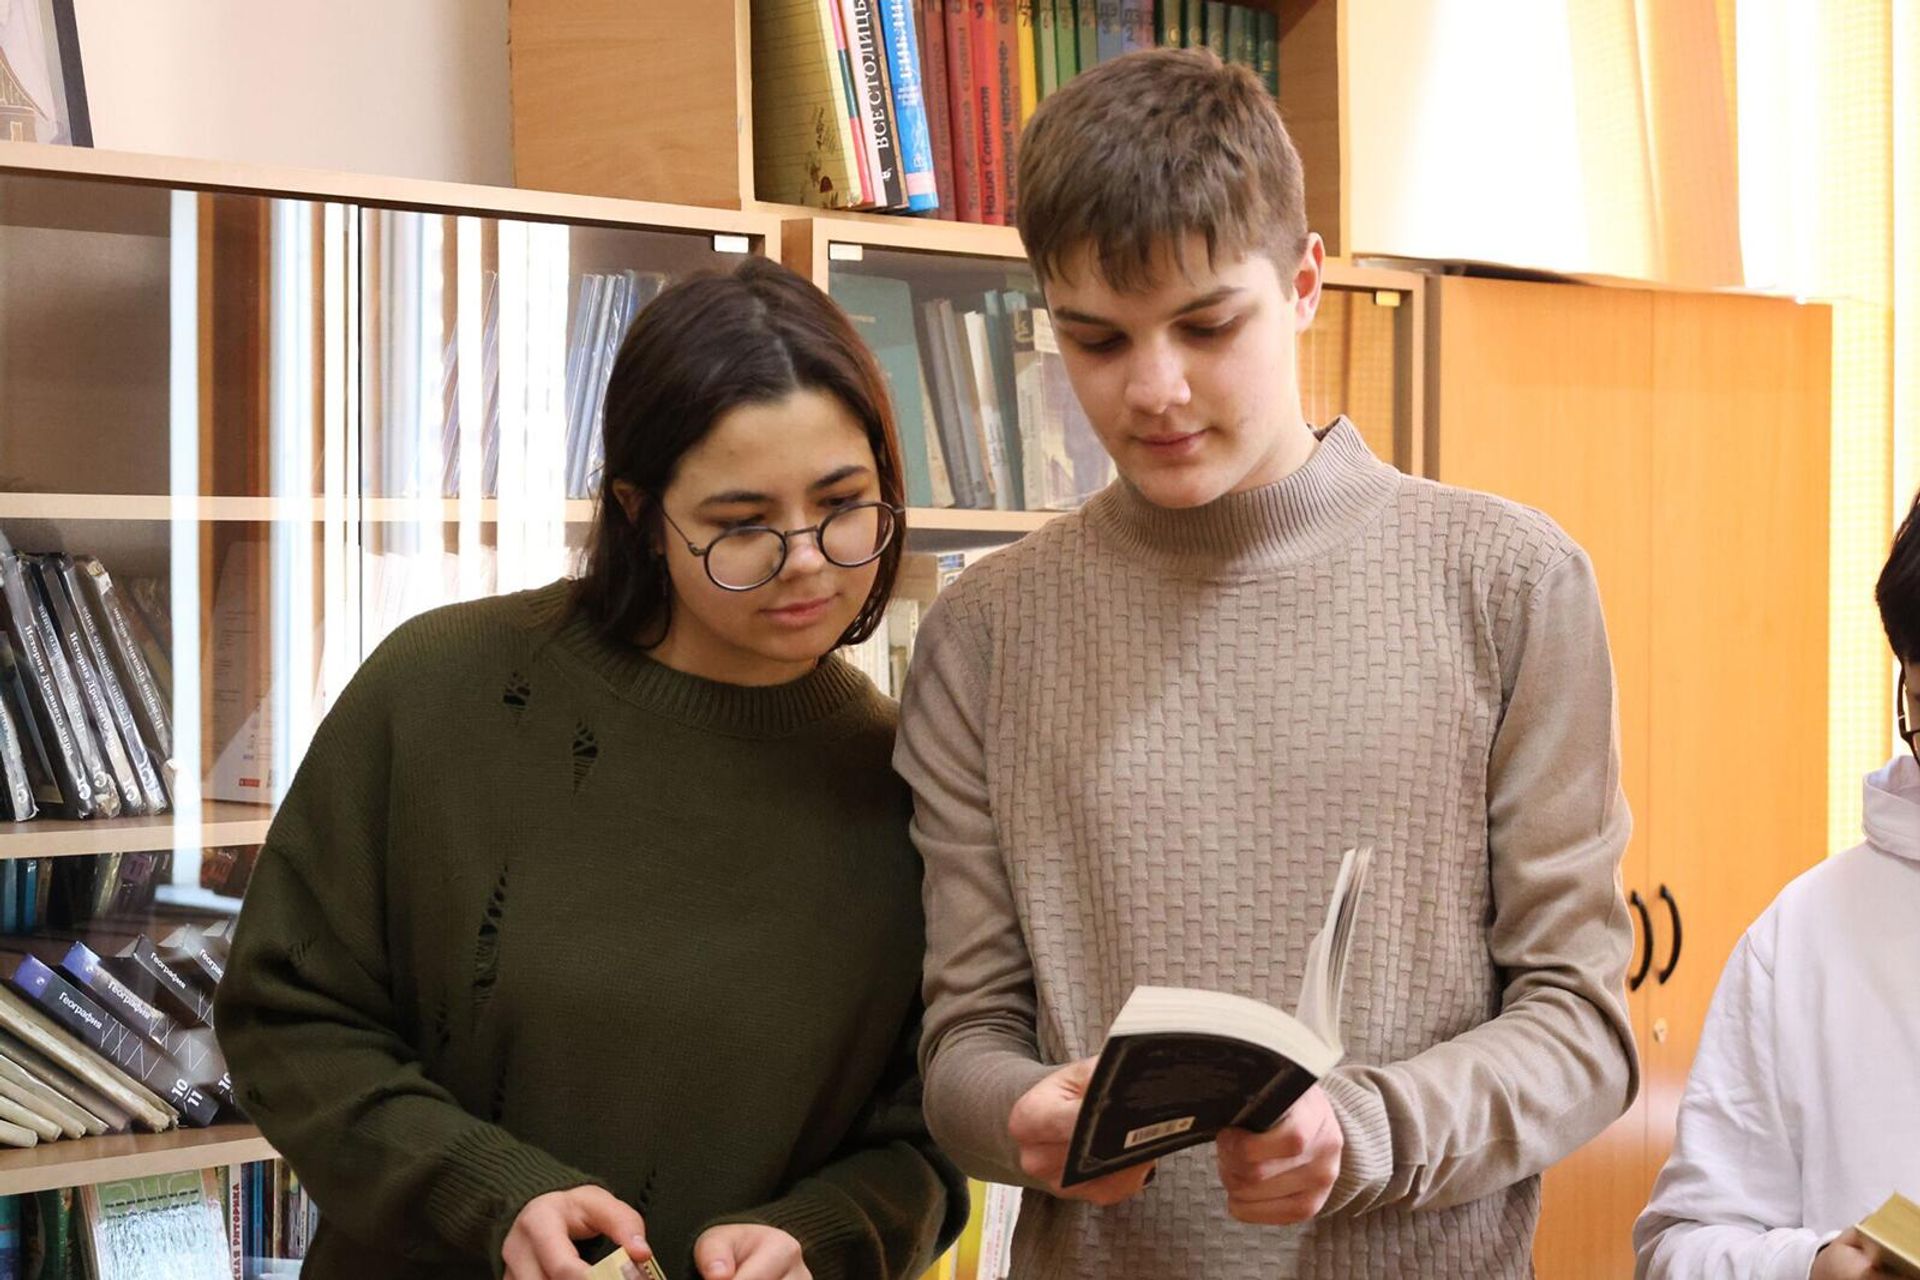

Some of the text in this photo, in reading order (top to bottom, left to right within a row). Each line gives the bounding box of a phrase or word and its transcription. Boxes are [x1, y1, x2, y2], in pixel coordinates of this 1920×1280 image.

[870, 108, 889, 150] ВСЕ
[976, 85, 995, 215] Наша Советская
[80, 605, 97, 635] мира
[22, 624, 75, 756] История Древнего мира
[66, 631, 92, 679] История
[84, 678, 112, 731] Древнего
[109, 684, 133, 729] История
[141, 682, 165, 729] История
[150, 953, 186, 989] География
[59, 992, 102, 1029] География
[108, 981, 151, 1020] География
[171, 1078, 203, 1107] 10 11
[232, 1183, 240, 1246] РИТОРИКА
